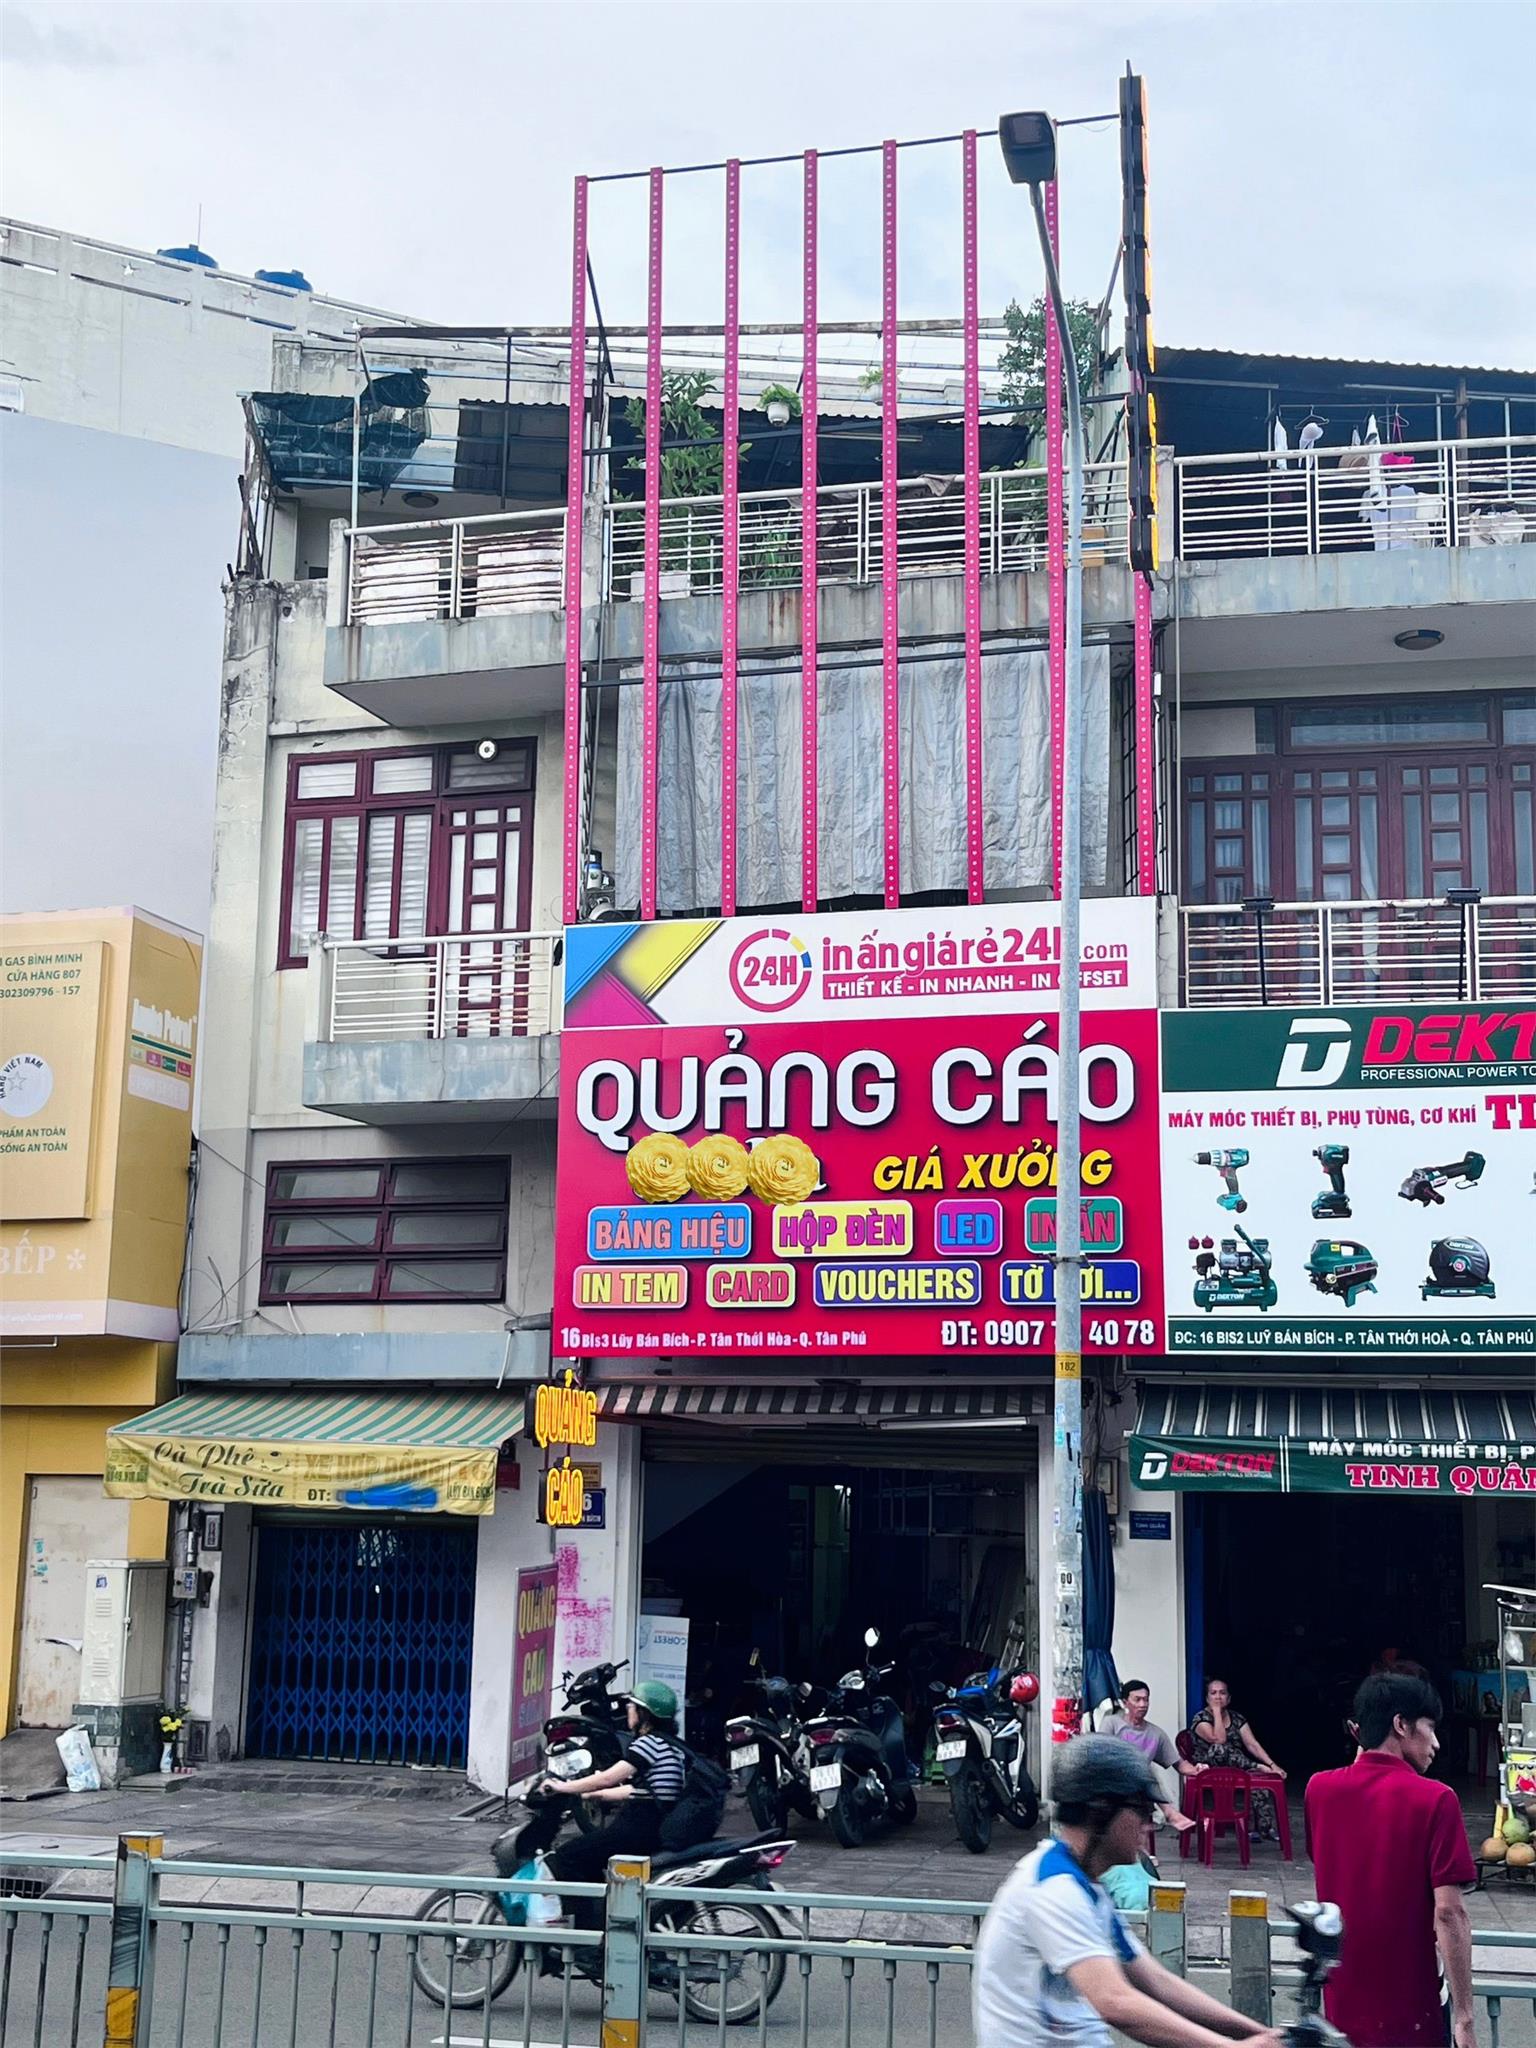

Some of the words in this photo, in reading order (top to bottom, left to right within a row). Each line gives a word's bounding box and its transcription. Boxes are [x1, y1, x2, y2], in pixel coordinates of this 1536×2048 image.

[5, 956, 26, 966] GAS
[28, 952, 52, 965] BÌNH
[55, 953, 82, 964] MINH
[744, 955, 797, 986] 24H
[7, 969, 28, 981] CỬA
[31, 969, 60, 980] HÀNG
[63, 969, 81, 979] 807
[828, 976, 874, 997] THIẾT
[881, 975, 902, 995] KẾ
[920, 978, 938, 994] IN
[945, 974, 1014, 993] NHANH
[1032, 973, 1050, 988] IN
[63, 985, 80, 995] 157
[576, 1028, 896, 1151] QUẢNG
[931, 1019, 1134, 1125] CÁO
[1361, 1067, 1464, 1080] PROFESSIONAL
[1467, 1066, 1518, 1078] POWER
[1168, 1109, 1203, 1127] MÁY
[1209, 1109, 1246, 1127] MÓC
[1251, 1106, 1295, 1126] THIẾT
[1301, 1111, 1322, 1129] BỊ,
[1327, 1109, 1360, 1128] PHỤ
[1366, 1107, 1415, 1126] TÙNG,
[1420, 1107, 1443, 1124] CƠ
[1448, 1104, 1476, 1123] KHÍ
[25, 1129, 39, 1137] AN
[27, 1144, 40, 1152] AN
[873, 1144, 943, 1191] GIÁ
[595, 1209, 671, 1251] BẢNG
[681, 1211, 745, 1254] HIỆU
[779, 1209, 837, 1254] HỘP
[846, 1208, 905, 1246] ĐÈN
[940, 1212, 994, 1246] LED
[581, 1272, 612, 1303] IN
[621, 1272, 679, 1303] TEM
[712, 1271, 789, 1302] CARD
[820, 1268, 975, 1300] VOUCHERS
[1006, 1264, 1044, 1299] TỜ
[710, 1332, 732, 1347] Tân
[816, 1331, 838, 1346] Tân
[842, 1330, 867, 1346] Phú
[941, 1320, 977, 1345] ĐT:
[984, 1320, 1045, 1345] 0907
[1088, 1319, 1119, 1345] 40
[1124, 1318, 1155, 1344] 78
[1174, 1331, 1197, 1344] ĐC:
[1200, 1331, 1213, 1344] 16
[1217, 1331, 1244, 1344] BIS2
[1247, 1329, 1271, 1344] LUỸ
[1275, 1329, 1301, 1344] BÁN
[1304, 1329, 1335, 1344] BÍCH
[1345, 1332, 1356, 1344] P.
[1358, 1329, 1384, 1344] TÂN
[1387, 1329, 1419, 1344] THỚI
[1422, 1329, 1450, 1344] HOÀ
[1461, 1332, 1474, 1345] Q.
[1477, 1329, 1503, 1344] TÂN
[1507, 1329, 1534, 1344] PHÚ
[1060, 1362, 1076, 1371] 182
[535, 1369, 597, 1448] QUẢNG
[154, 1441, 186, 1463] Cà
[197, 1442, 255, 1469] Phê
[1308, 1438, 1355, 1456] MÁY
[1363, 1437, 1412, 1457] MÓC
[1419, 1440, 1478, 1459] THIẾT
[1170, 1452, 1276, 1473] DEKTON
[178, 1472, 226, 1495] Trà
[234, 1474, 285, 1498] Sữa
[1345, 1464, 1440, 1488] TINH
[307, 1488, 331, 1501] ĐT:
[546, 1456, 583, 1525] CÁO
